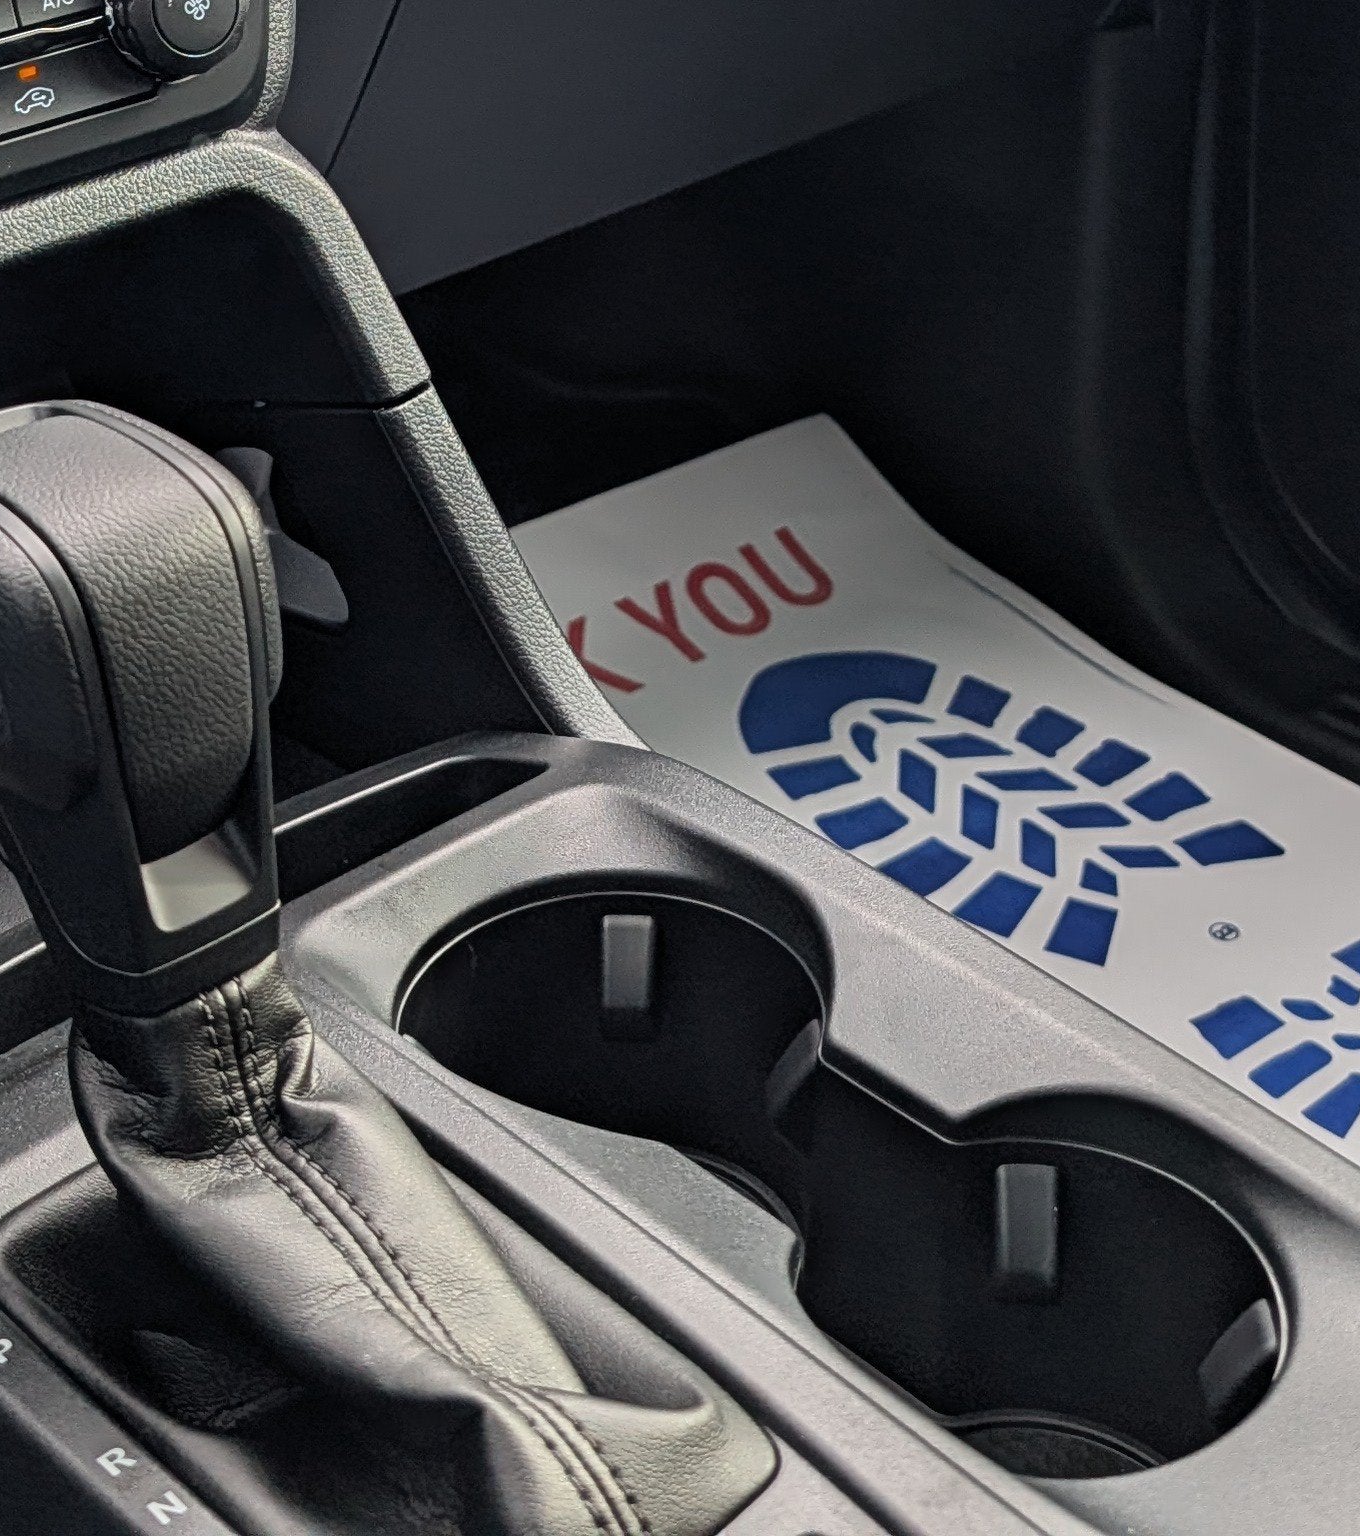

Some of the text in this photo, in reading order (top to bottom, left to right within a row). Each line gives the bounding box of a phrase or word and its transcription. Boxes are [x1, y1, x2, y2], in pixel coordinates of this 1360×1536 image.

[613, 525, 835, 664] YOU
[96, 1447, 138, 1477] R
[145, 1490, 188, 1526] N
